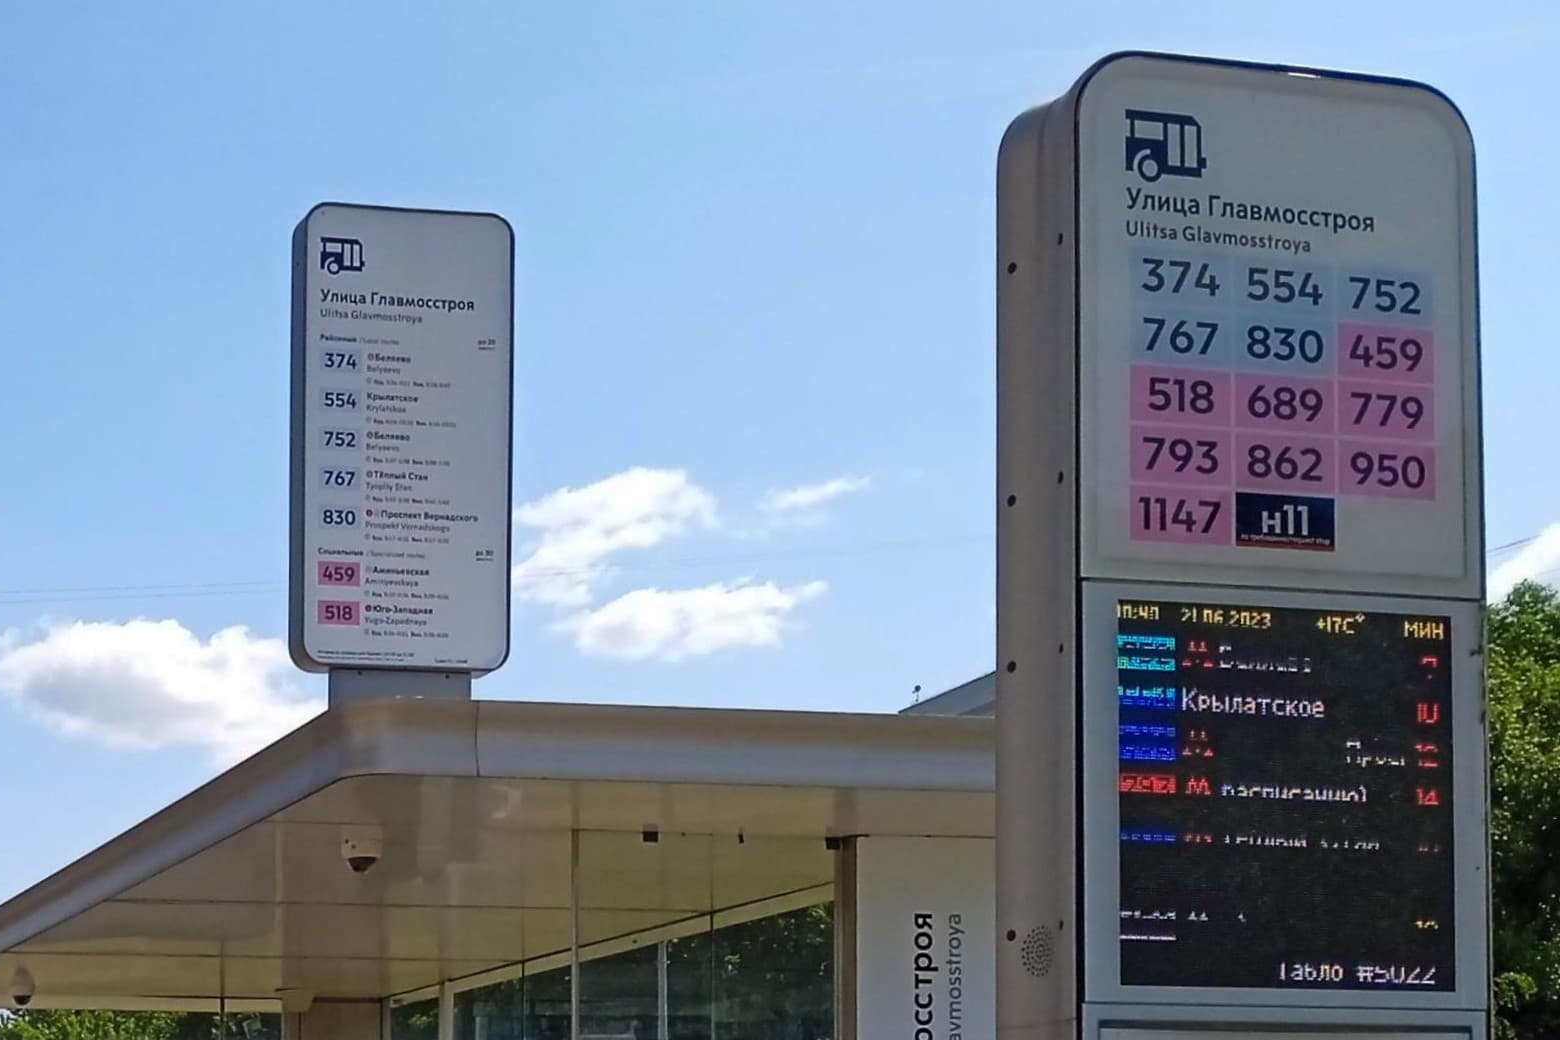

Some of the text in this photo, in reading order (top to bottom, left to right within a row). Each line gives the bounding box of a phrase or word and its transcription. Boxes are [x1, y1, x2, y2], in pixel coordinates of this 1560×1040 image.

[1126, 187, 1375, 233] Улица Главмосстроя
[1126, 220, 1311, 254] Ulitsa Glavmosstroya
[1142, 258, 1422, 315] 374 554 752
[320, 289, 475, 314] Улица Главмосстроя
[320, 309, 423, 325] Ulitsa Glavmosstroya
[1143, 317, 1423, 372] 767 830 459
[324, 352, 357, 369] 374
[324, 392, 357, 409] 554
[1148, 377, 1424, 429] 518 689 779
[324, 431, 356, 448] 752
[1143, 437, 1425, 489] 793 862 950
[323, 470, 356, 486] 767
[323, 509, 356, 526] 830
[1139, 497, 1221, 534] 1147
[322, 566, 355, 582] 459
[324, 605, 353, 622] 518
[1182, 686, 1326, 718] Крылатское
